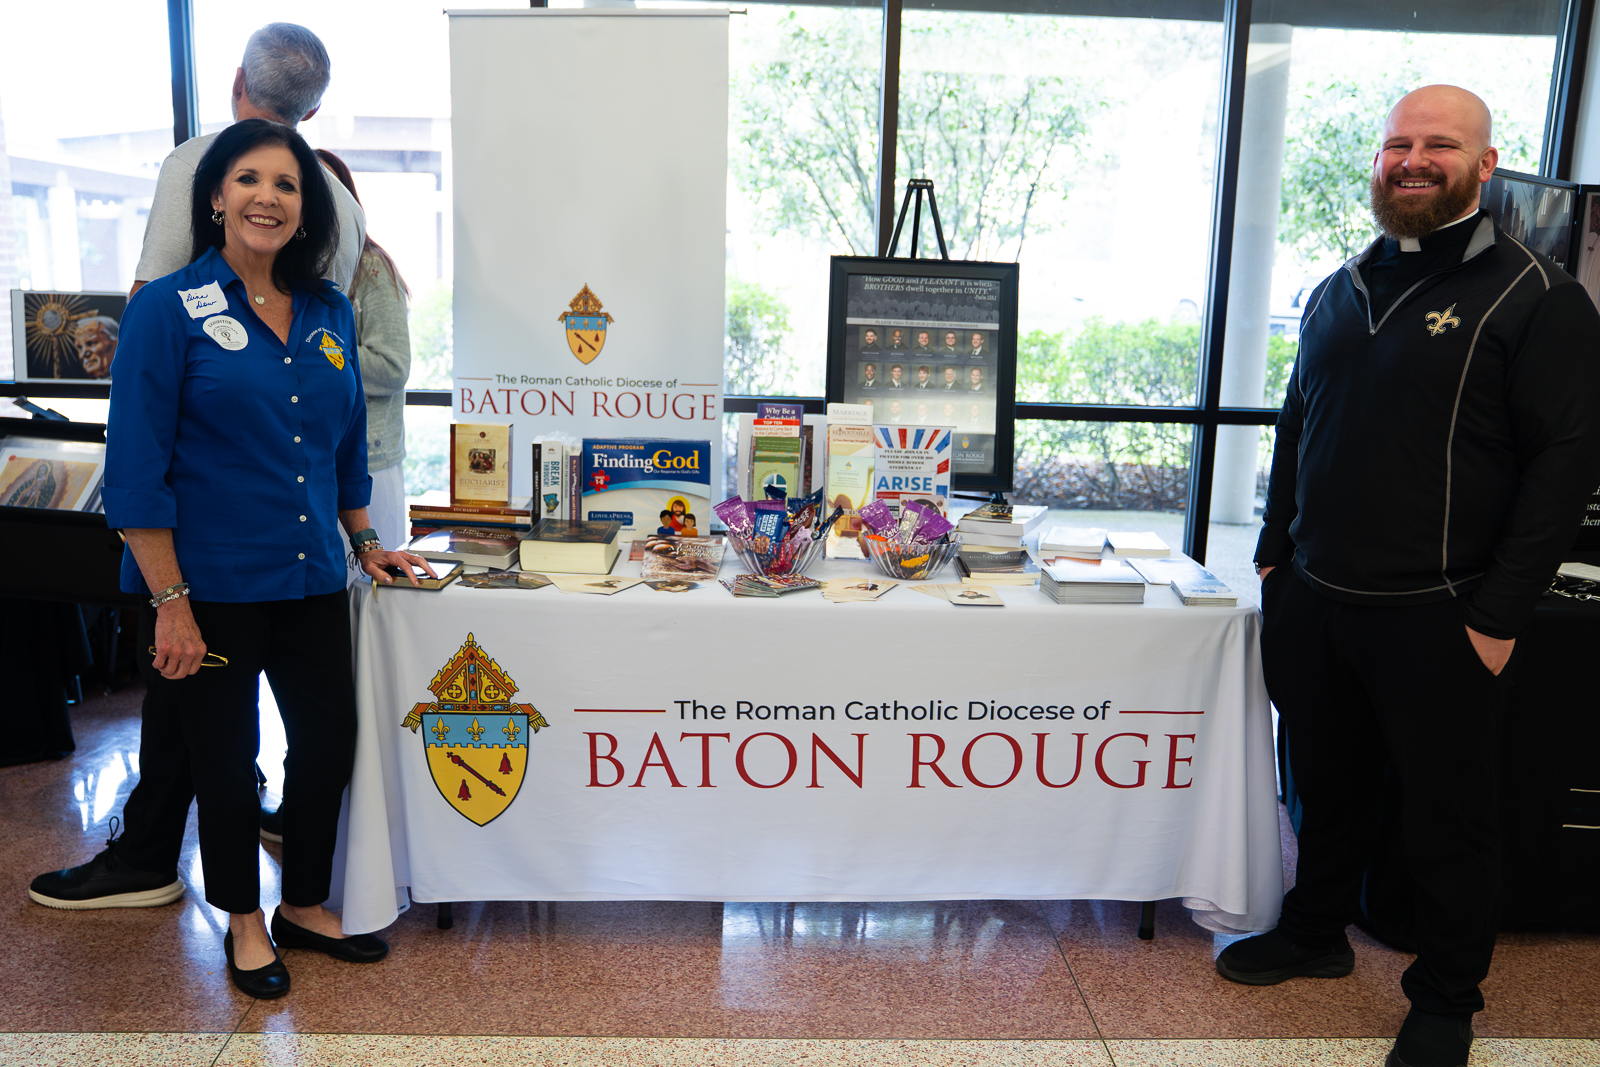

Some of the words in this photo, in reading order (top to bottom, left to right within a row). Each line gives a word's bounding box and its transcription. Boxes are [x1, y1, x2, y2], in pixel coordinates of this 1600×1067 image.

[882, 276, 904, 284] GOOD
[920, 278, 958, 286] PLEASANT
[864, 283, 905, 292] BROTHERS
[925, 287, 954, 295] together
[496, 374, 517, 384] The
[521, 375, 562, 386] Roman
[565, 376, 613, 387] Catholic
[617, 377, 662, 388] Diocese
[665, 378, 678, 388] of
[460, 388, 576, 416] BATON
[592, 391, 716, 420] ROUGE
[765, 407, 781, 415] Why
[592, 453, 653, 474] Finding
[652, 449, 700, 469] God
[551, 461, 560, 486] BREAK
[459, 478, 506, 487] EUCHARIST
[876, 476, 932, 491] ARISE
[674, 700, 726, 720] The
[736, 700, 835, 720] Roman
[844, 700, 958, 721] Catholic
[968, 700, 1075, 721] Diocese
[1083, 700, 1111, 720] of
[582, 731, 870, 789] BATON
[906, 731, 1197, 789] ROUGE
